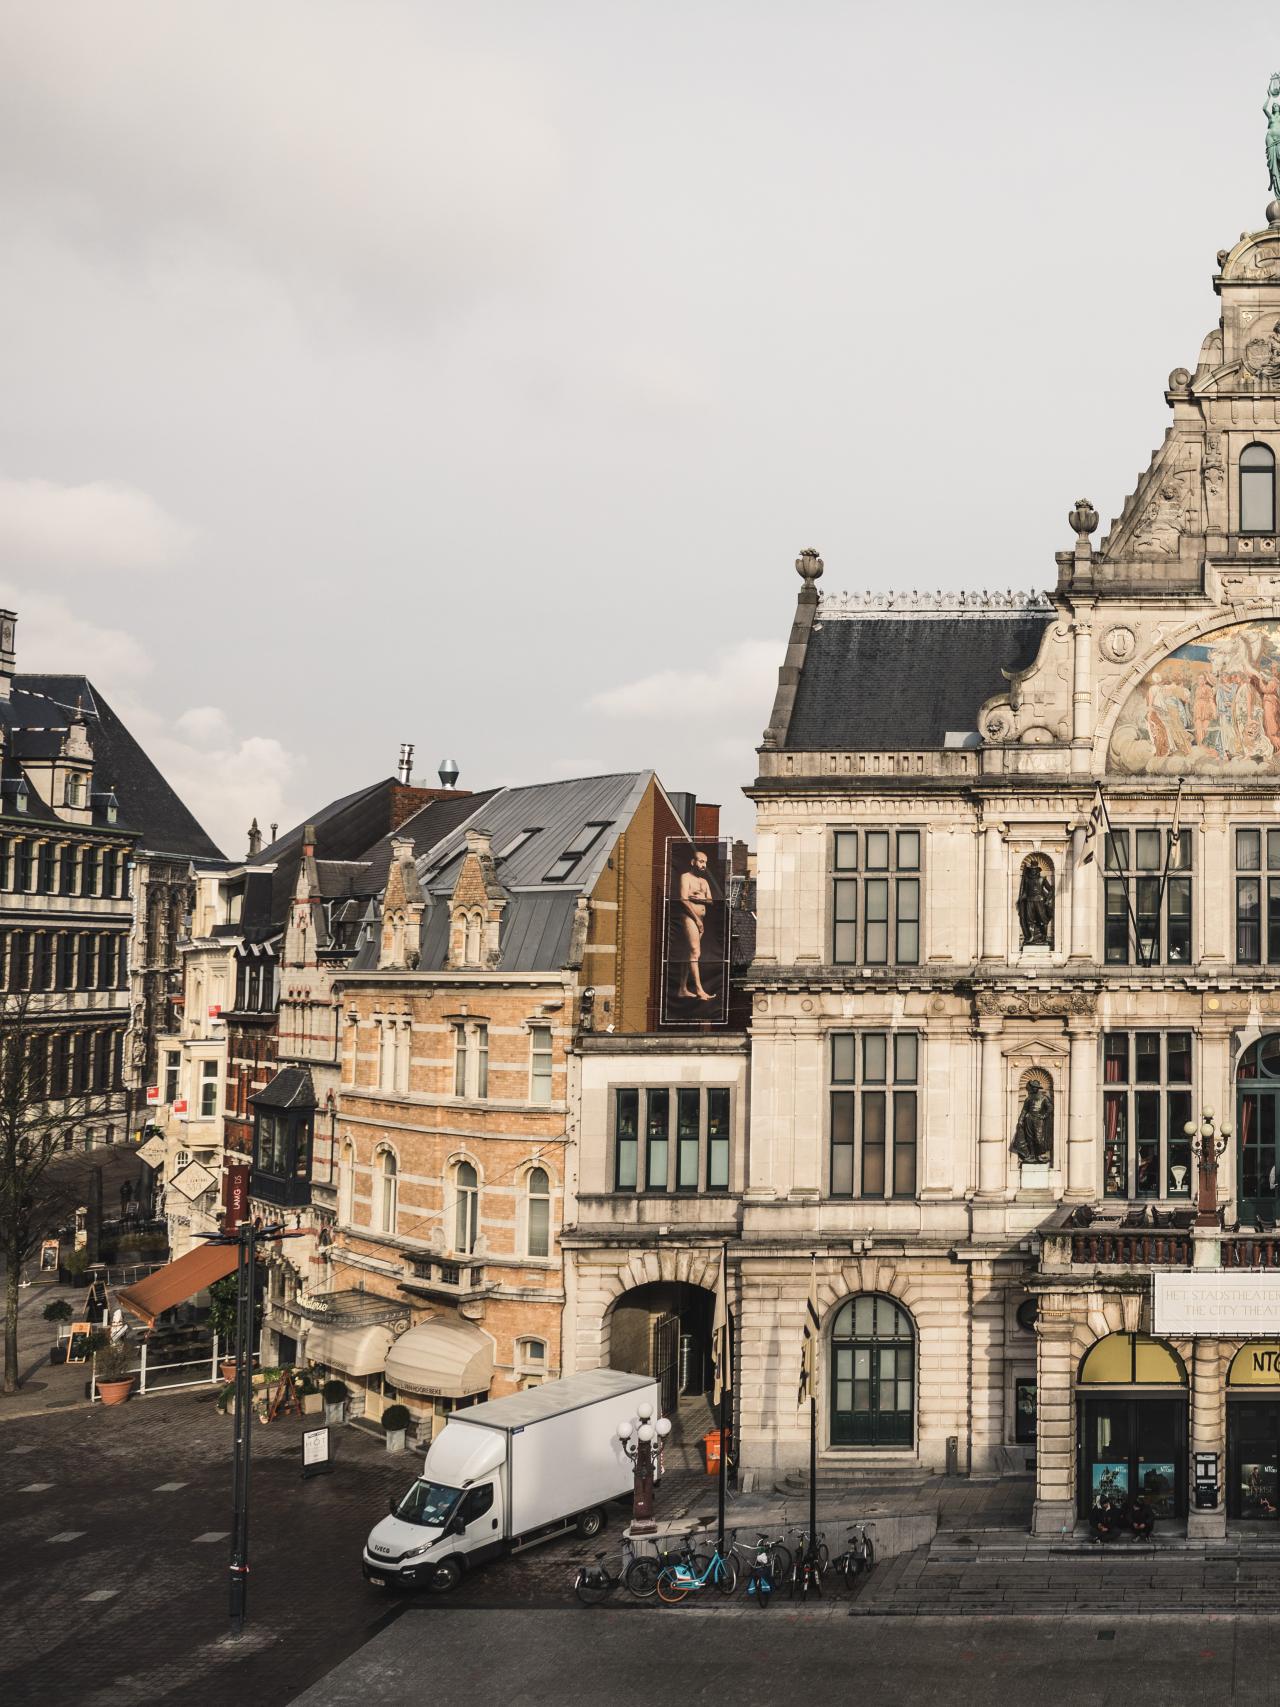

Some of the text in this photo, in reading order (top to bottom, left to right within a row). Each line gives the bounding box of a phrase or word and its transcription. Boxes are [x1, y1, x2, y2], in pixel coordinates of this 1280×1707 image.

[233, 1175, 242, 1210] LAMGDS
[1166, 1289, 1186, 1301] HET
[1184, 1304, 1204, 1316] THE
[1209, 1304, 1237, 1316] CITY
[374, 1544, 391, 1554] IVECO
